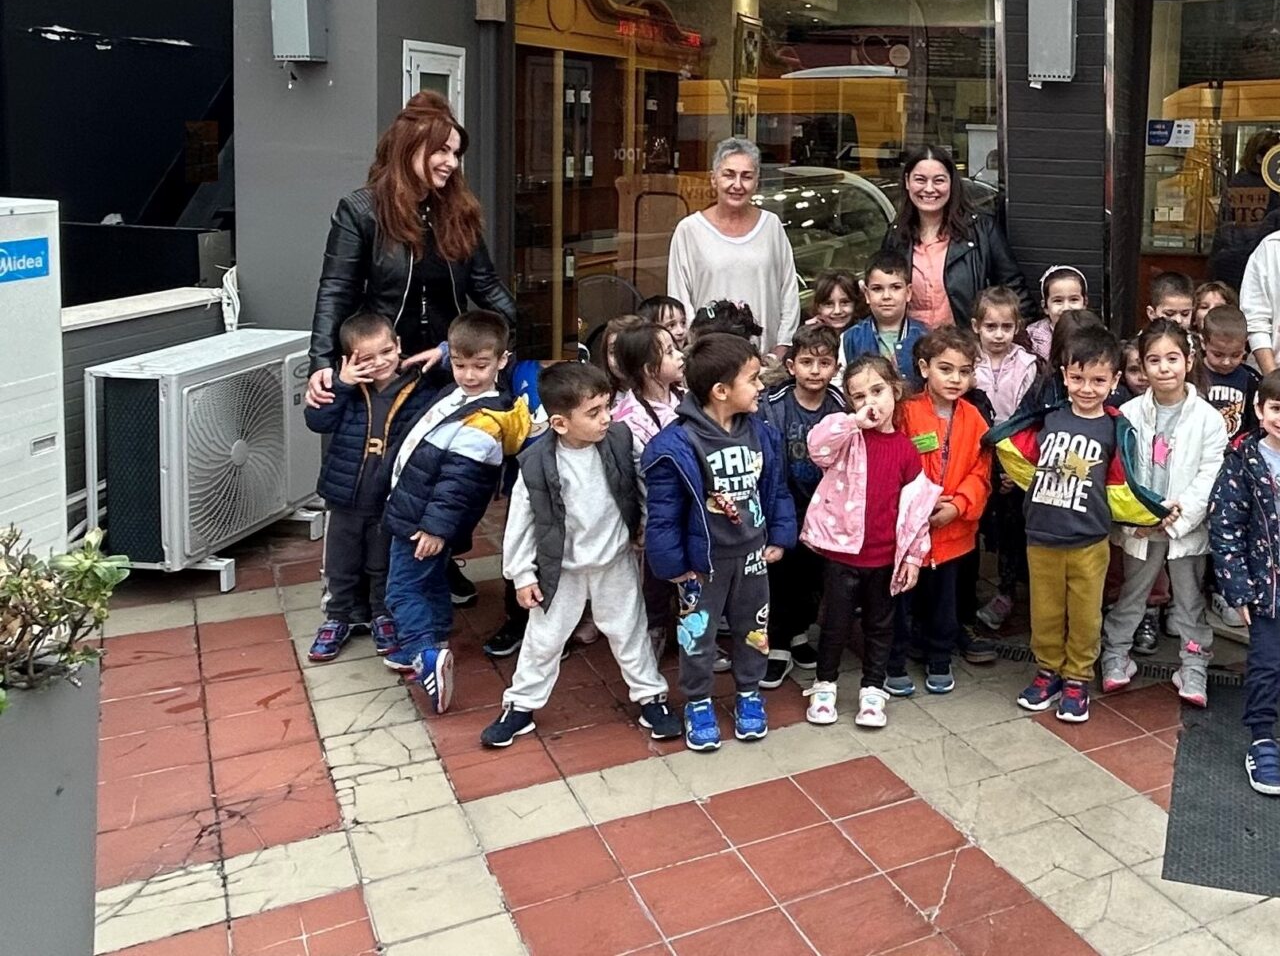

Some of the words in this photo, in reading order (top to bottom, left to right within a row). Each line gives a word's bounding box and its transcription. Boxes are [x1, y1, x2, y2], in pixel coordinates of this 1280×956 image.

[0, 251, 43, 273] Midea
[1037, 431, 1102, 467] DROP
[1031, 469, 1093, 513] ZONE
